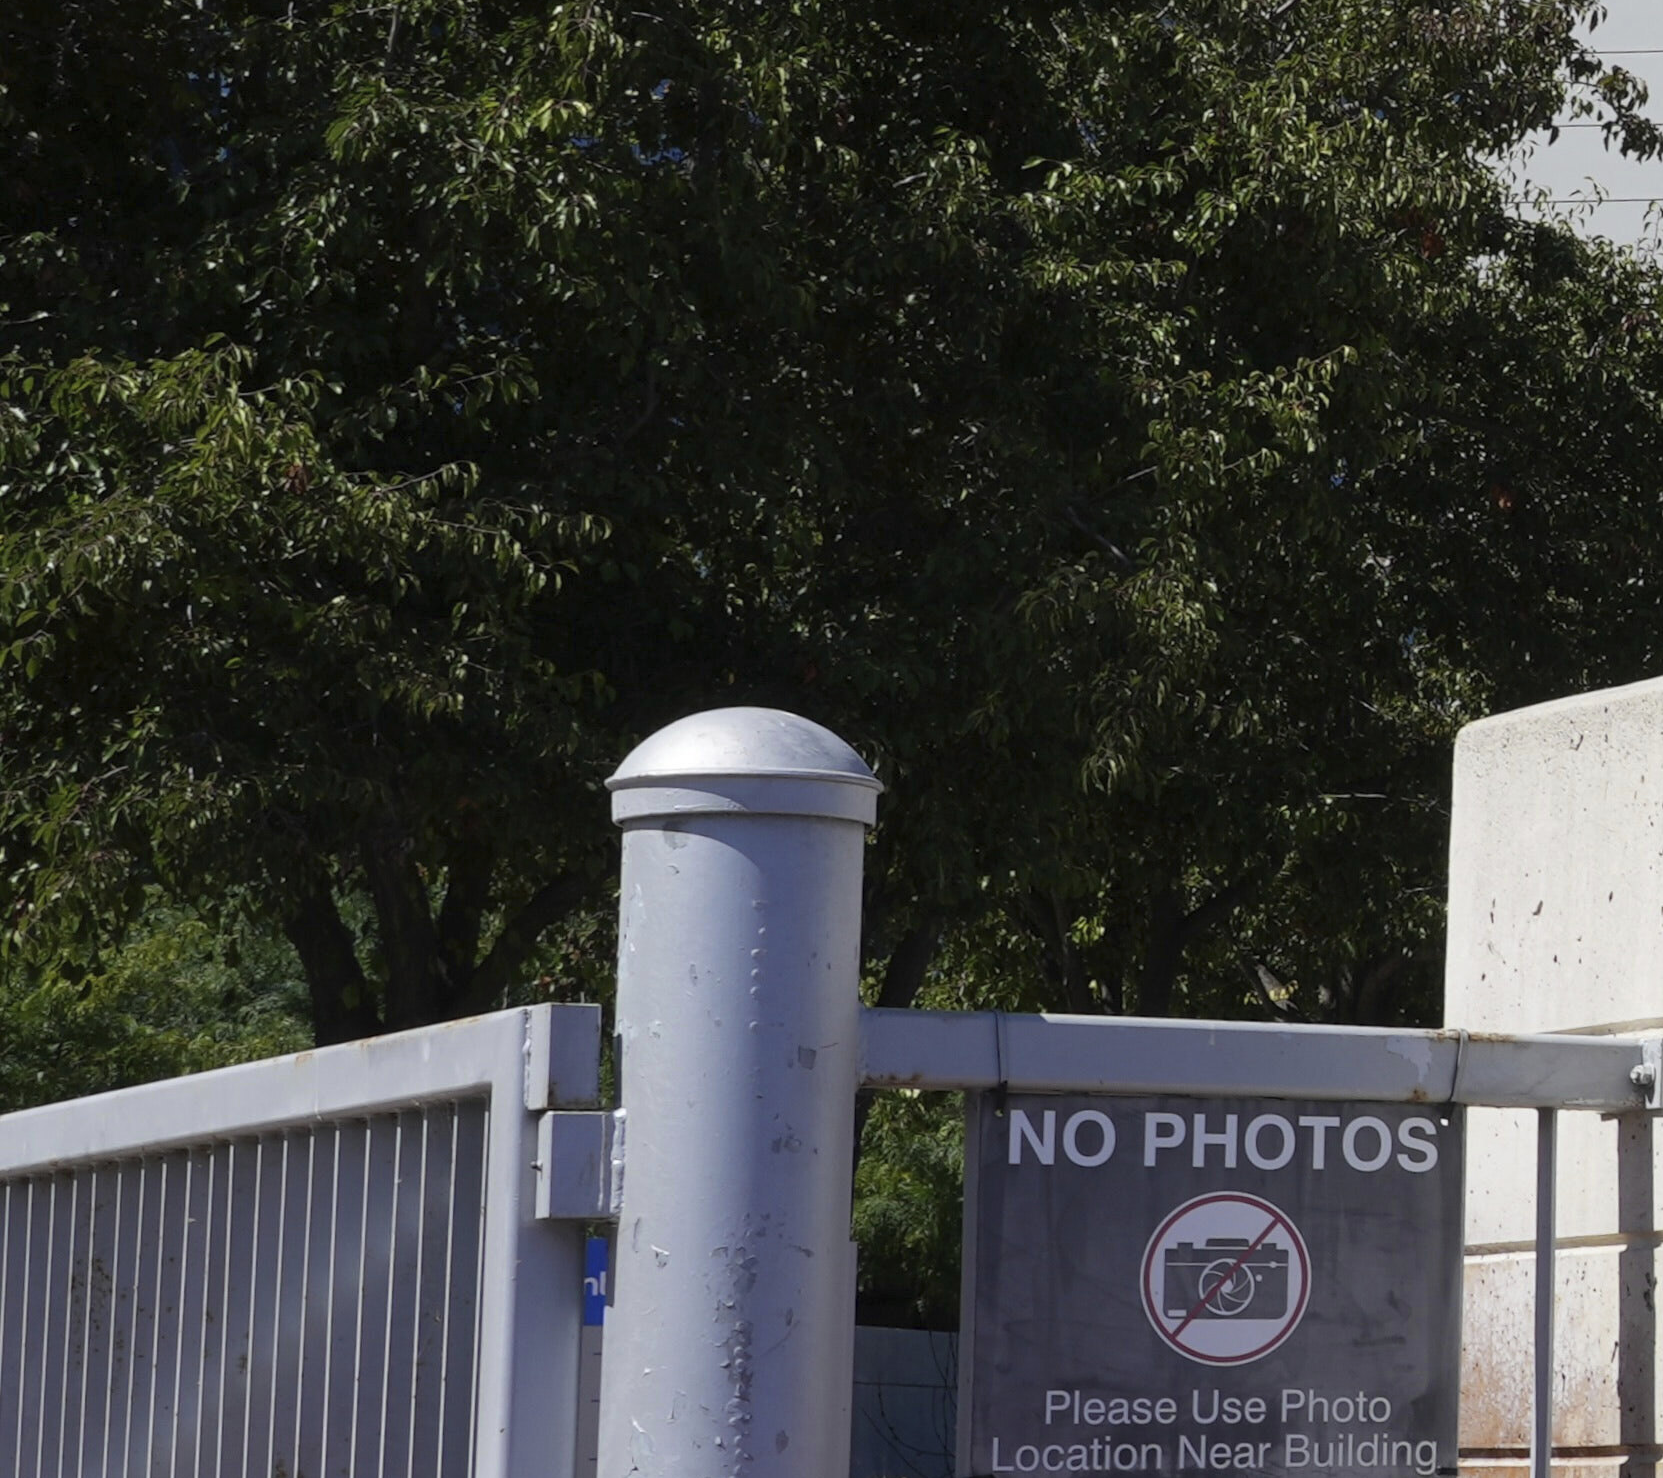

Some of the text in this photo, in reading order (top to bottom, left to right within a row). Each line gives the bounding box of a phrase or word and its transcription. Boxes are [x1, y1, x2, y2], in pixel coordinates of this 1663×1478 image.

[1007, 1109, 1439, 1173] NO PHOTOS
[1045, 1390, 1391, 1424] Please Use Photo
[991, 1434, 1438, 1475] Location Near Building
